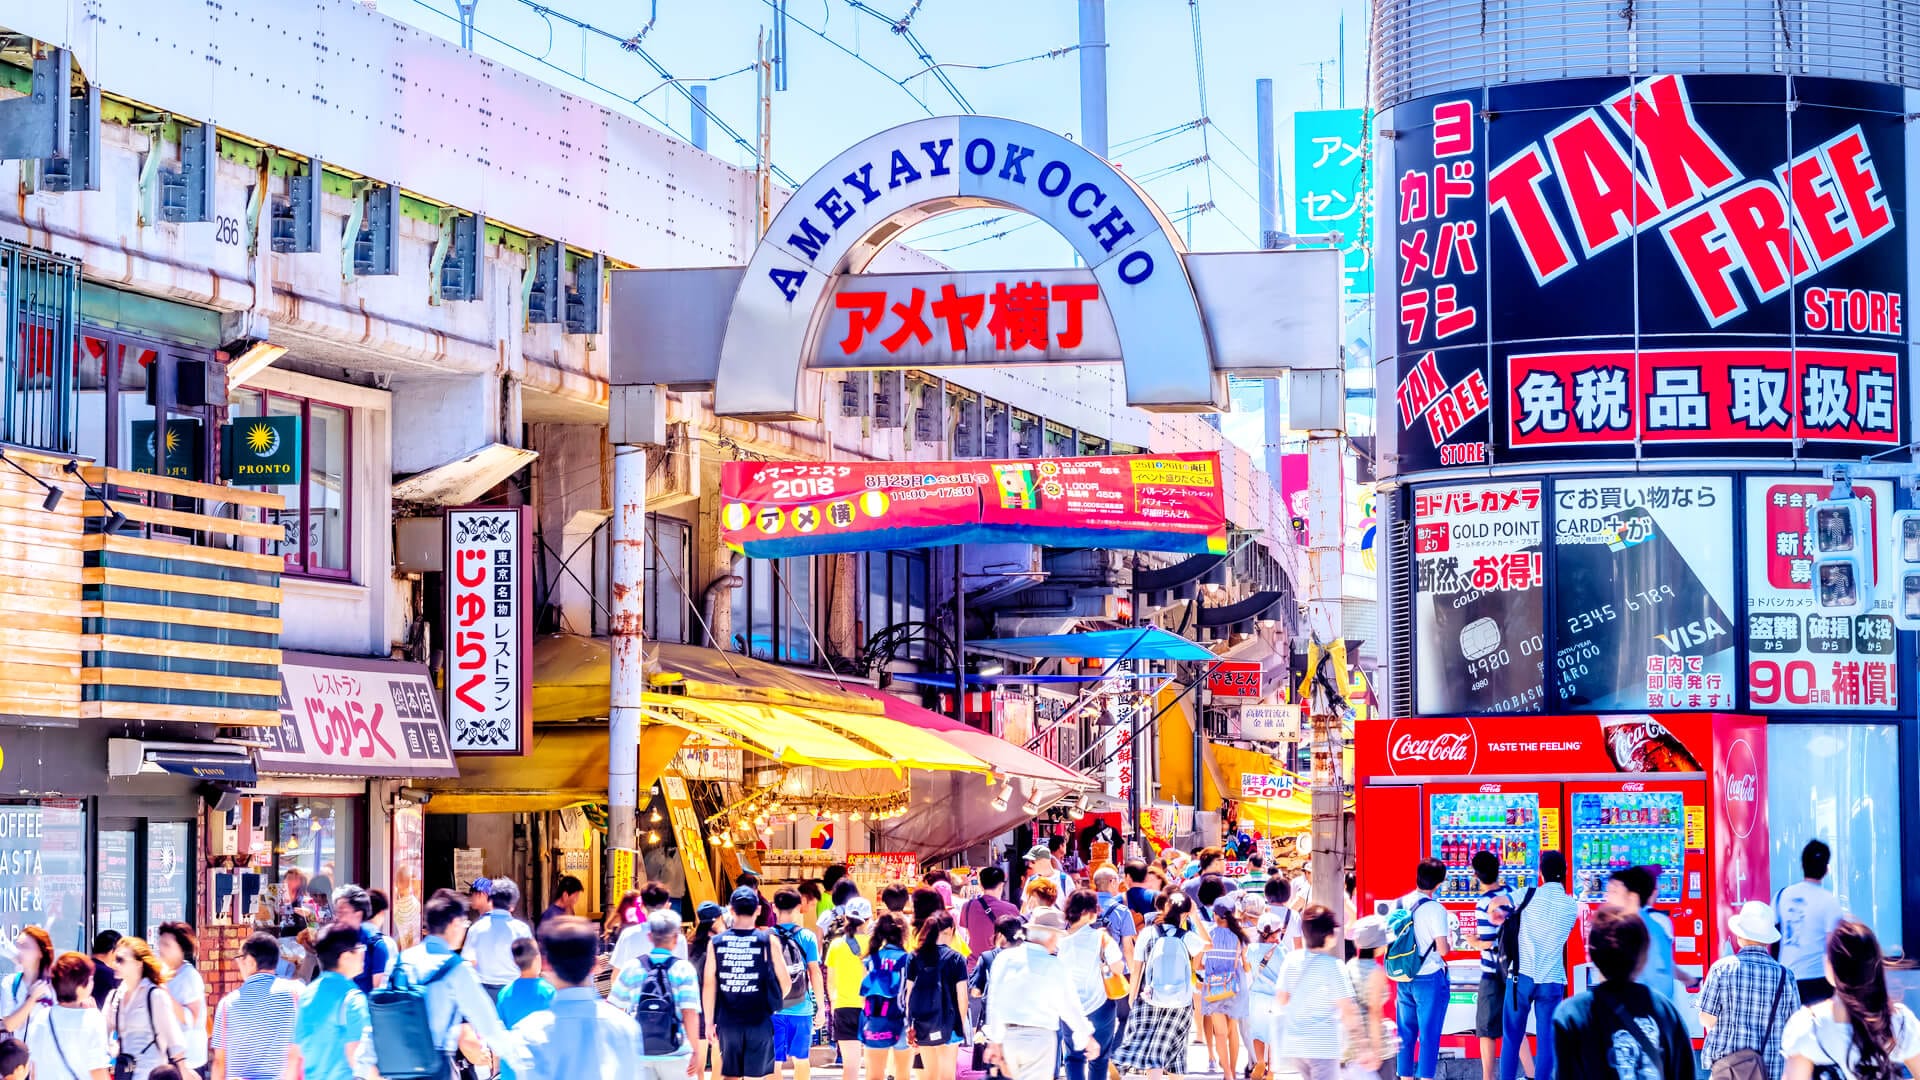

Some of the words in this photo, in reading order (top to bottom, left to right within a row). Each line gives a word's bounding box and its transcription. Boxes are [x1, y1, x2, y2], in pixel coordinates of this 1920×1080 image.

[1488, 73, 1745, 287] TAX
[216, 215, 238, 245] 266
[768, 138, 1154, 302] AMEYAYOKOCHO
[1433, 99, 1477, 340] ヨドバシ
[1659, 124, 1896, 329] FREE
[1400, 170, 1430, 344] カメラ
[835, 281, 1099, 353] アメヤ横丁
[1805, 287, 1901, 335] STORE
[1397, 351, 1448, 430] TAX
[1518, 364, 1895, 433] 免税品取扱店
[1425, 368, 1489, 448] FREE
[1440, 441, 1485, 465] STORE
[239, 464, 291, 475] PRONTO
[753, 465, 851, 484] サマーフェスタ
[773, 477, 835, 499] 2018
[1415, 488, 1540, 517] ヨドバシカメラ
[1554, 486, 1716, 509] でお買い物なら
[761, 504, 851, 528] アメ横
[1417, 526, 1446, 539] 他カード
[1453, 523, 1489, 539] GOLD
[1494, 521, 1540, 537] POINT
[1557, 519, 1602, 534] CARD
[1424, 540, 1439, 551] より
[495, 551, 511, 616] 東京名物
[1453, 591, 1479, 608] GOLD
[1748, 598, 1813, 607] ヨドバシカメラ
[455, 549, 487, 712] じゅらく
[1468, 649, 1510, 678] 4980
[1568, 604, 1616, 634] 2345
[1624, 584, 1675, 612] 6789
[1653, 616, 1727, 653] VISA
[1750, 617, 1798, 640] 盗難
[1809, 617, 1850, 640] 破損
[1857, 618, 1892, 640] 水没
[1557, 645, 1600, 669] 00/00
[1765, 640, 1783, 650] から
[1822, 640, 1838, 650] から
[1868, 642, 1882, 651] から
[494, 623, 511, 711] レストラン
[1558, 664, 1588, 685] ARO
[1647, 655, 1704, 672] 店内で
[312, 673, 361, 696] レストラン
[1211, 672, 1257, 685] やきとん
[1647, 674, 1722, 690] 即時発行
[392, 686, 433, 713] 総本店
[1559, 684, 1576, 699] 89
[304, 697, 397, 760] じゅらく
[407, 728, 441, 753] 直営
[1392, 733, 1471, 761] Coca-Cola
[1487, 743, 1517, 752] TASTE
[1519, 743, 1537, 751] THE
[1540, 742, 1580, 751] FEELING
[1727, 774, 1755, 802] Coca-Cola
[0, 888, 30, 912] INE
[33, 888, 42, 912] &
